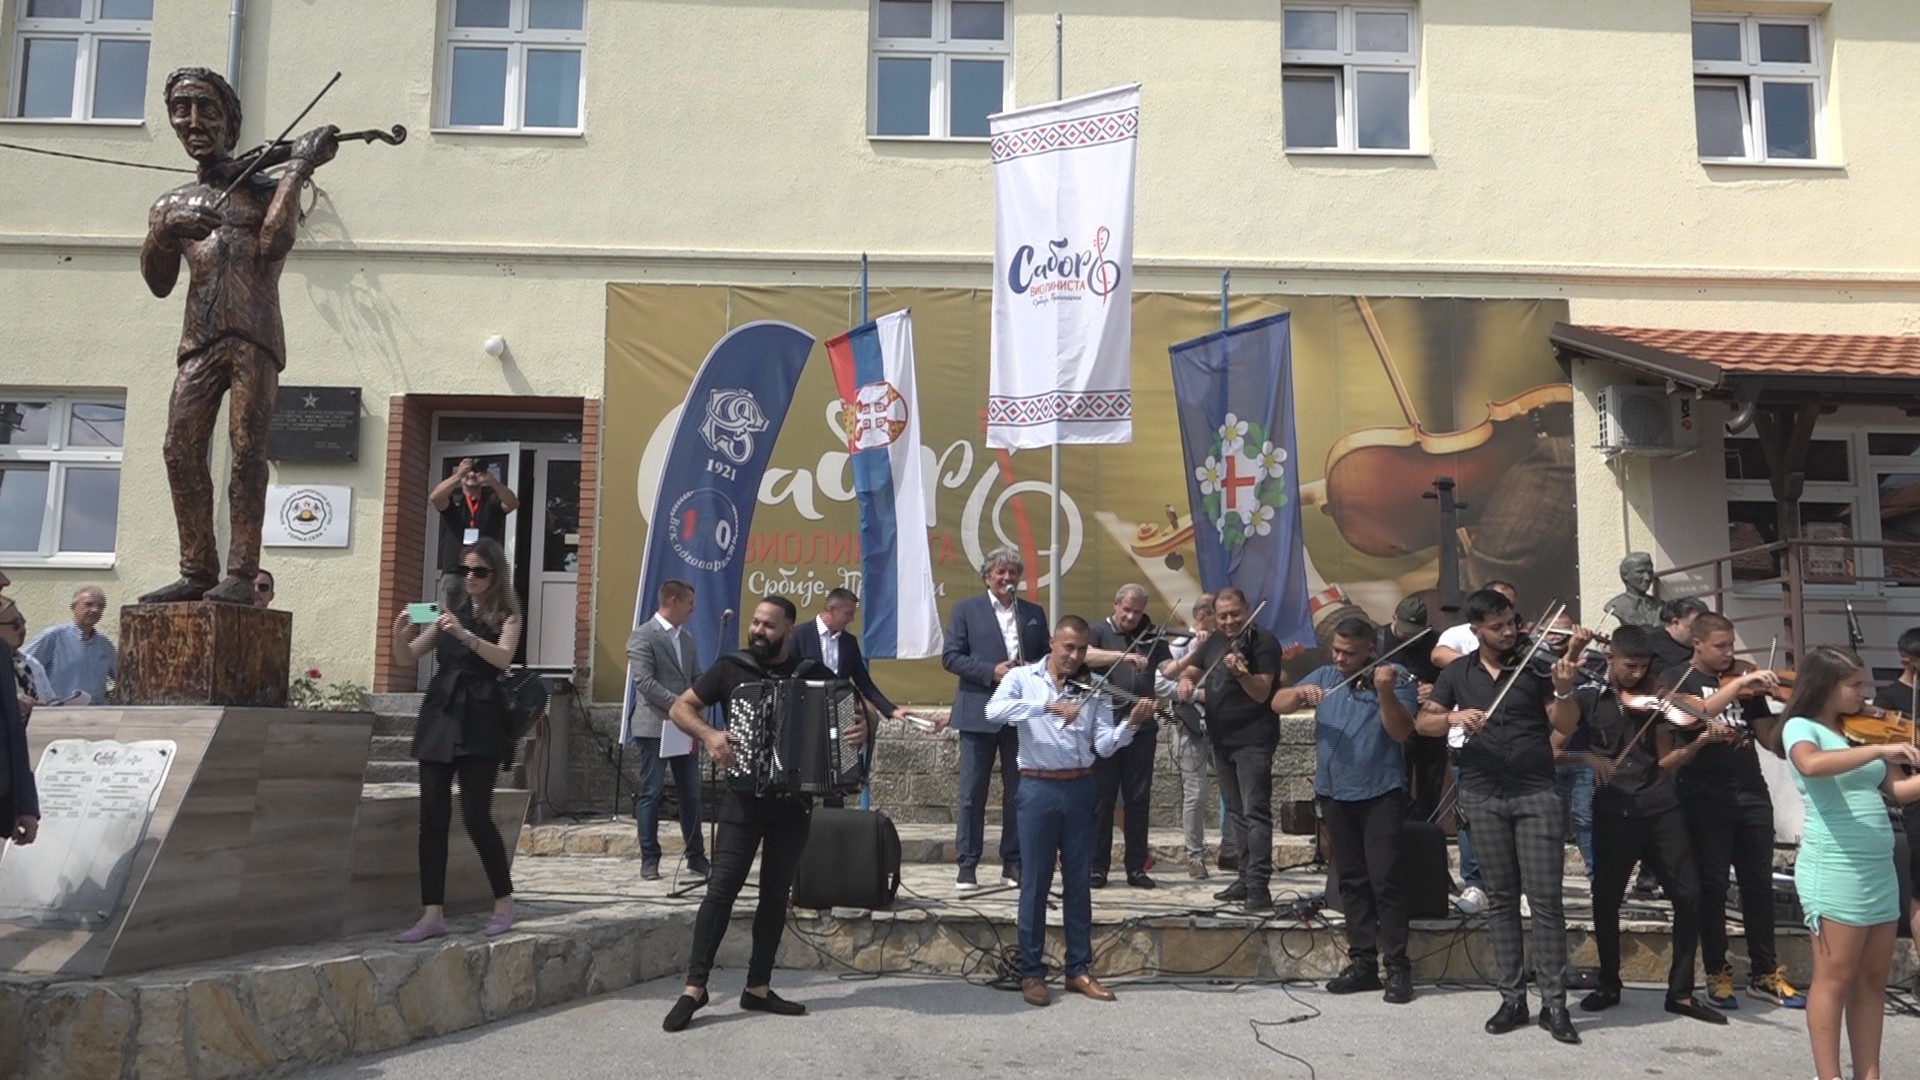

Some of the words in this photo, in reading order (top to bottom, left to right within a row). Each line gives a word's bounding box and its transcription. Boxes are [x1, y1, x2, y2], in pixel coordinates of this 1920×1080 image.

[1008, 237, 1092, 294] Сабор
[1030, 280, 1085, 297] ВИОЛИНИСТА
[706, 459, 737, 481] 1921
[748, 566, 832, 609] Србије,
